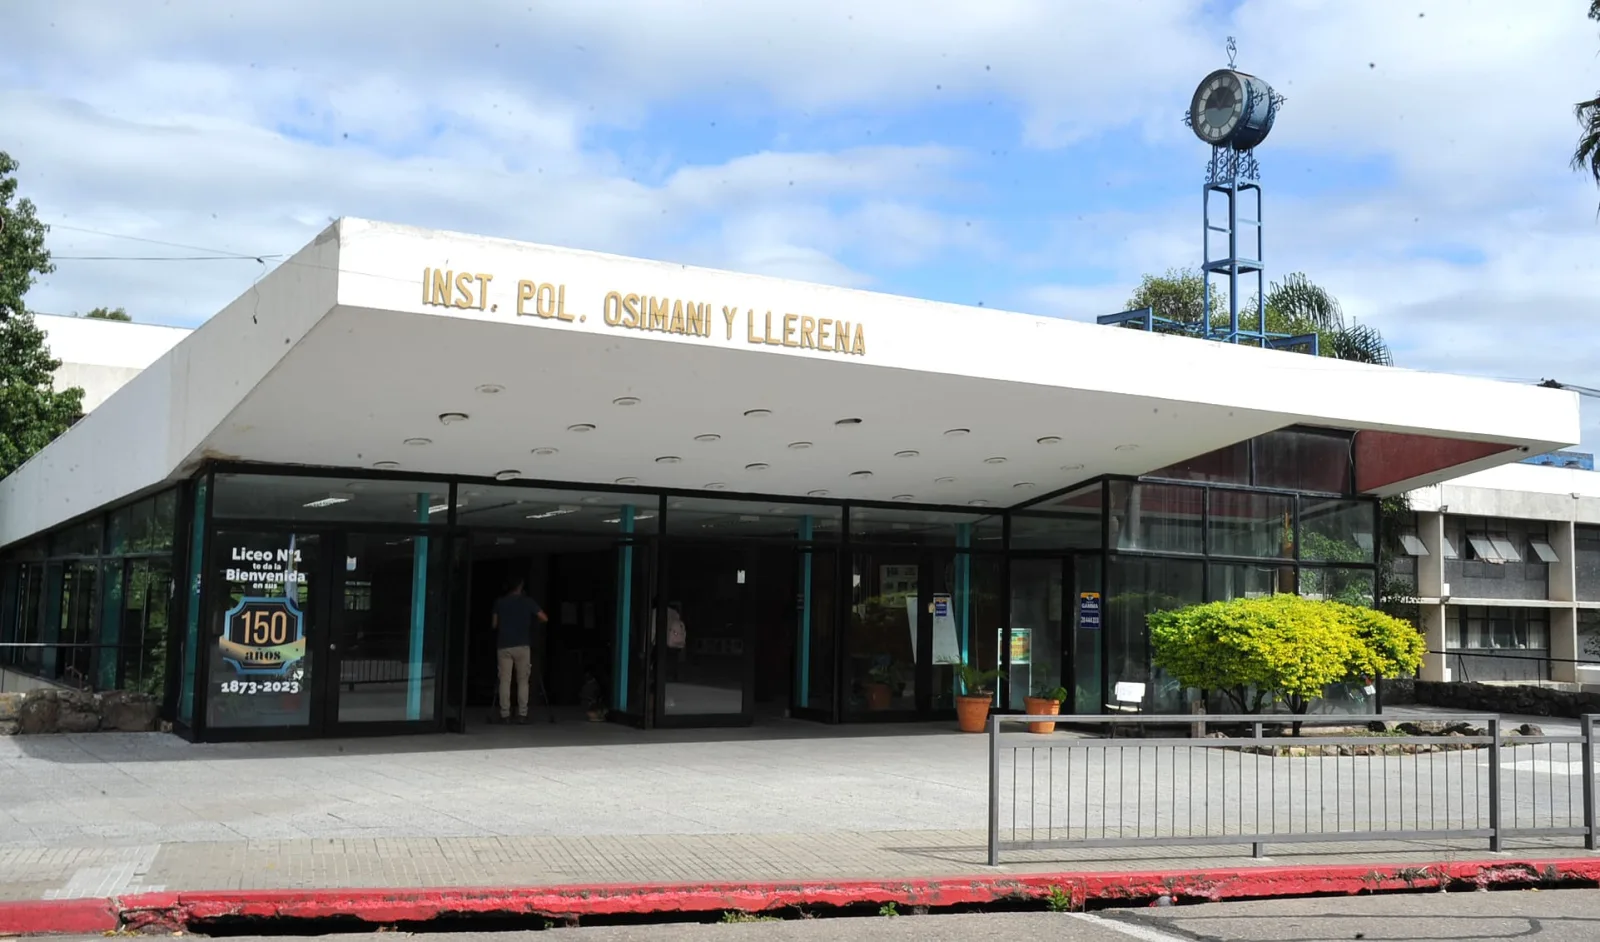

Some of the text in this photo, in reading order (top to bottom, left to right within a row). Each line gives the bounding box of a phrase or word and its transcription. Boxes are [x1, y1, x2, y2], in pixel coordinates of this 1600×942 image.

[422, 267, 866, 356] INST. POL. OSIMANI Y LLERENA
[232, 547, 273, 561] Liceo
[226, 569, 305, 582] Bienvenida
[241, 610, 287, 644] 150
[221, 681, 299, 694] 1873-2023
